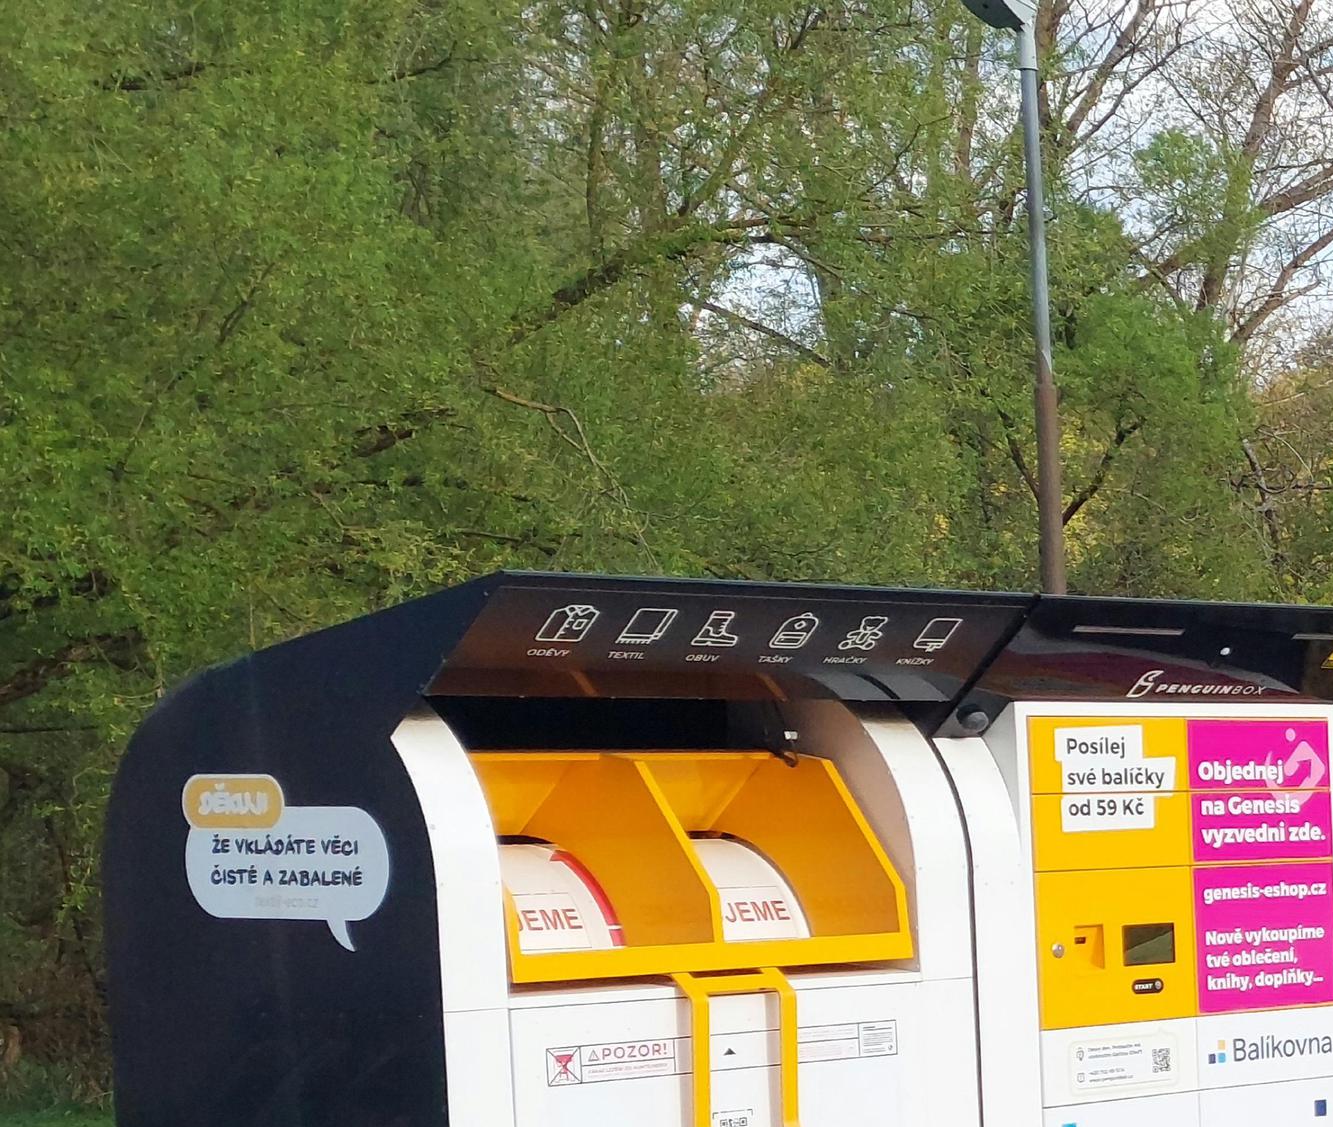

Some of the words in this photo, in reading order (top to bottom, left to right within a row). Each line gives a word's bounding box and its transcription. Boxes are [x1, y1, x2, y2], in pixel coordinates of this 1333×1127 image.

[527, 648, 570, 657] ODĚVY
[608, 650, 645, 660] TEXTIL
[685, 654, 720, 663] OBUV
[758, 654, 795, 664] TAŠKY
[823, 655, 868, 664] HRAČKY
[1155, 683, 1266, 695] PENGUINBOX
[1066, 737, 1126, 759] Posílej
[1067, 768, 1097, 786] své
[1102, 766, 1165, 789] balíčky
[1198, 760, 1285, 785] Objednej
[1068, 799, 1091, 816] od
[1097, 799, 1117, 816] 59
[1123, 797, 1145, 816] Kč
[1201, 800, 1225, 816] na
[1228, 794, 1301, 815] Genesis
[211, 834, 230, 854] ŽE
[235, 834, 316, 855] VKLÁDÁTE
[320, 835, 359, 856] VĚCI
[1201, 821, 1285, 849] vyzvedni
[1288, 821, 1327, 842] zde.
[210, 864, 258, 885] ČISTÉ
[262, 869, 273, 885] A
[278, 866, 363, 887] ZABALENÉ
[1203, 881, 1327, 905] genesis-eshop.cz
[1205, 929, 1243, 946] Nově
[1245, 925, 1325, 946] vykoupíme
[1206, 953, 1229, 968] tvé
[1232, 946, 1298, 967] oblečení,
[1135, 983, 1154, 991] START
[1207, 973, 1253, 992] knihy,
[602, 1043, 668, 1060] POZOR!
[1233, 1034, 1333, 1062] Balíkovna
